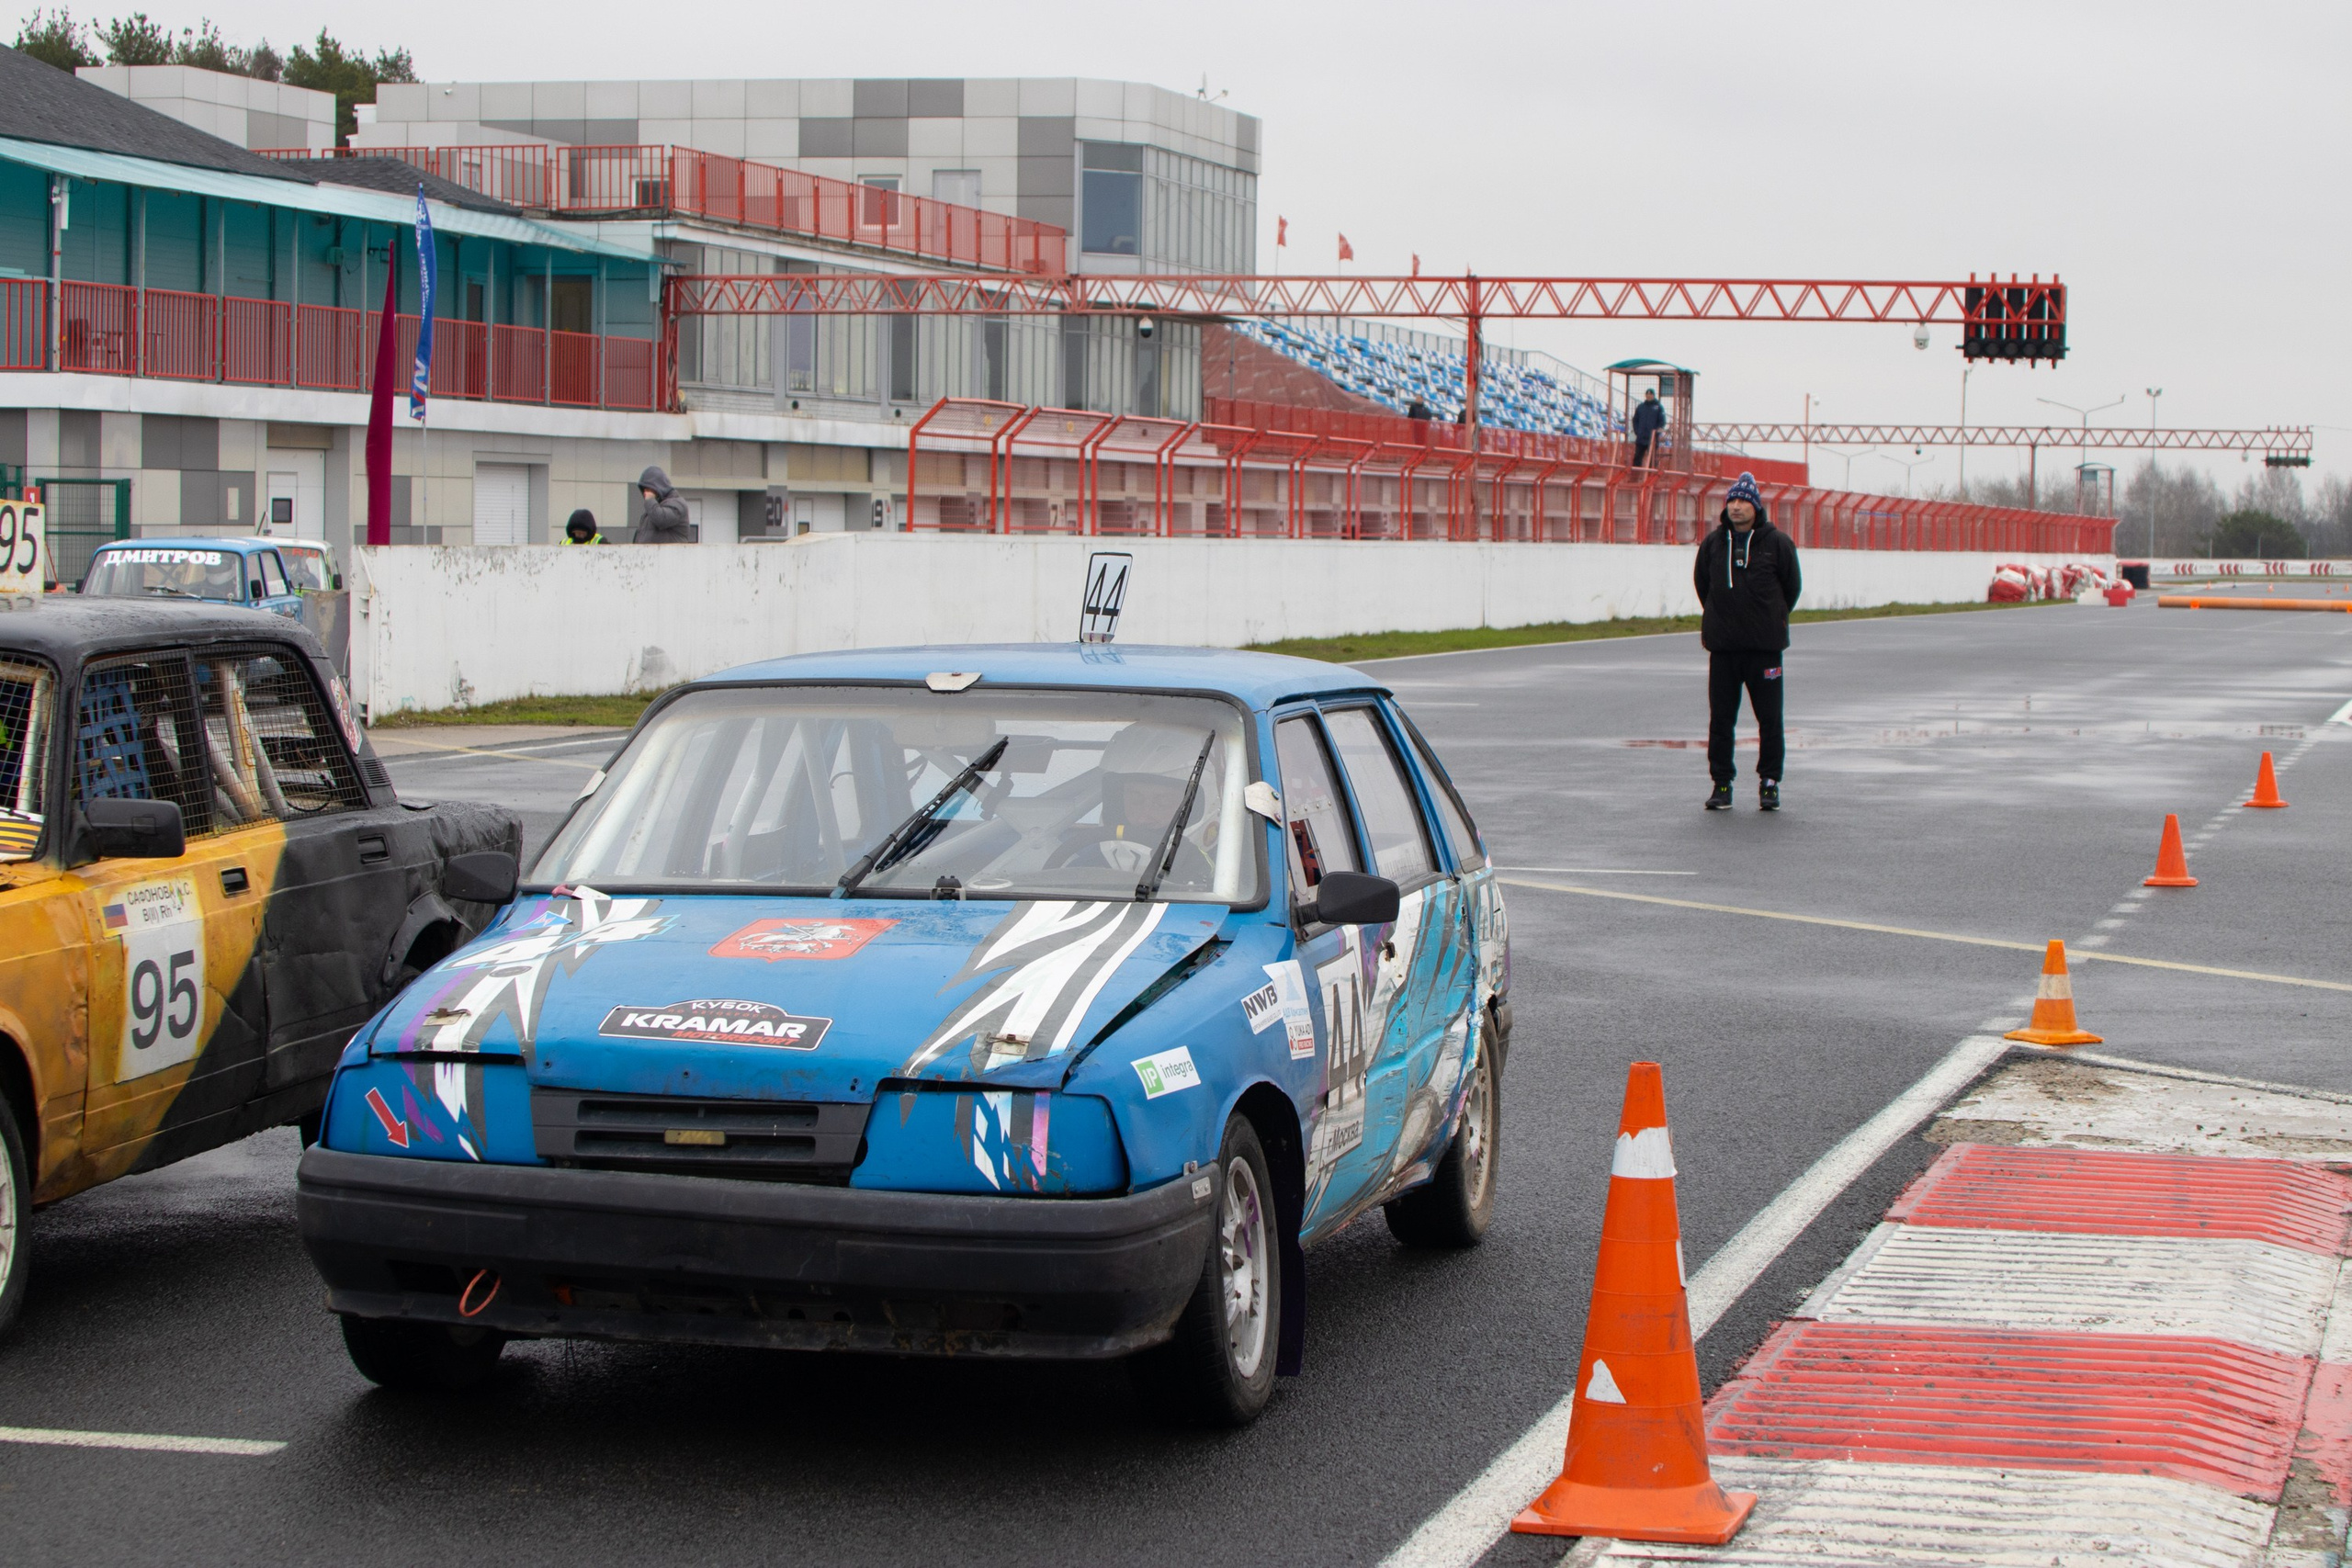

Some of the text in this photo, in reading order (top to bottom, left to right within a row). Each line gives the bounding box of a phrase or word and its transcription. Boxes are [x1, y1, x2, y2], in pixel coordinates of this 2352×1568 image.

[0, 505, 39, 575] 95
[104, 550, 221, 567] ДМИТРОВ
[1085, 562, 1127, 632] 44
[131, 950, 198, 1049] 95
[691, 1001, 767, 1014] КУБОК
[1243, 985, 1278, 1020] NWB
[621, 1013, 807, 1039] KRAMAR
[671, 1031, 799, 1046] MOTORSPORT
[1329, 973, 1366, 1111] 44
[1142, 1060, 1194, 1089] IP integra
[1326, 1120, 1360, 1157] г.Москва
